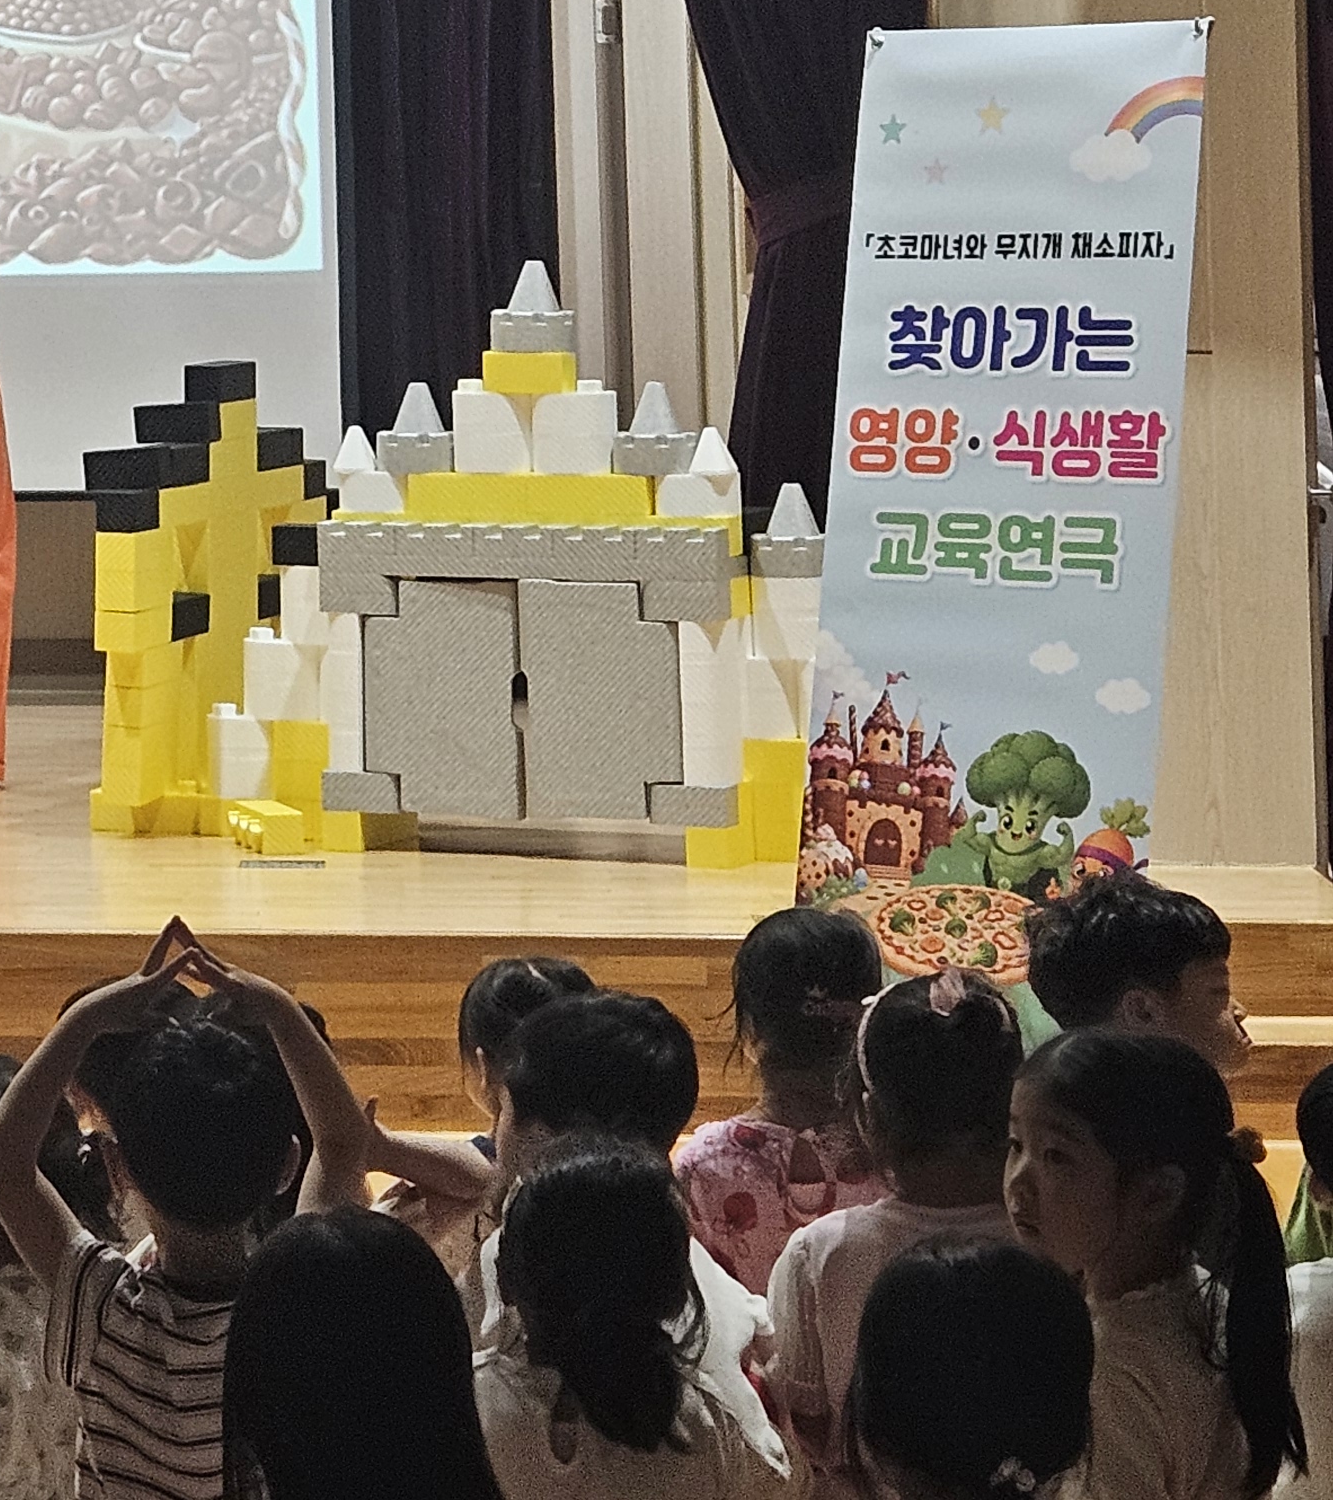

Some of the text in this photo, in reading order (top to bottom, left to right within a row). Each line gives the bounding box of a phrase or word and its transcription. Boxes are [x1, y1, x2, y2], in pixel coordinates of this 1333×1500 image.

[994, 232, 1063, 260] 무지개
[887, 304, 1135, 372] 찾아가는
[869, 510, 1119, 585] 교육연극
